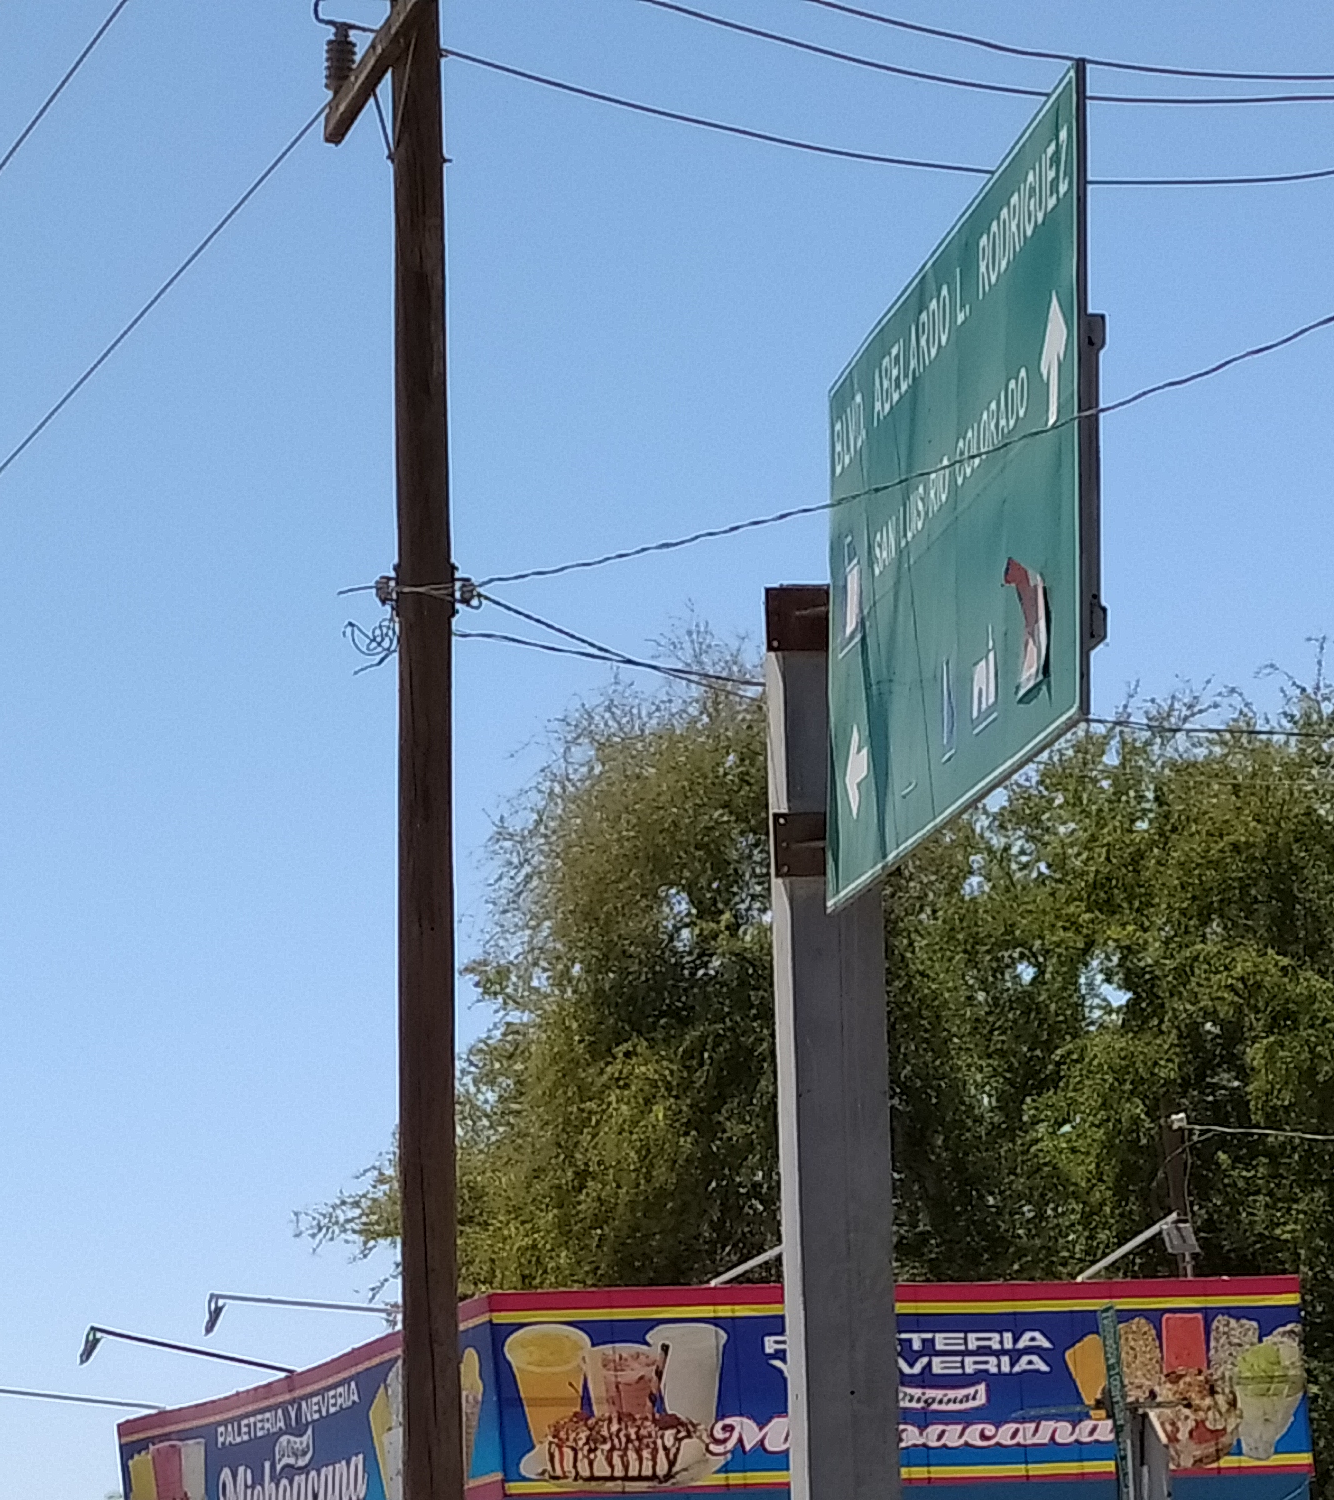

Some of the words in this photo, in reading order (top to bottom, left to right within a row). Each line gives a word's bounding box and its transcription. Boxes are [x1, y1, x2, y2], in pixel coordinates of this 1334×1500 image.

[873, 283, 951, 427] ABELARDO
[956, 267, 970, 326] L.
[978, 123, 1069, 300] RODRIGUEZ
[873, 515, 896, 577] SAN
[899, 483, 925, 548] LUIS
[955, 366, 1028, 487] COLORADO
[217, 1407, 286, 1449] PALETERIA
[288, 1403, 298, 1428] Y
[301, 1380, 360, 1424] NEVERIA
